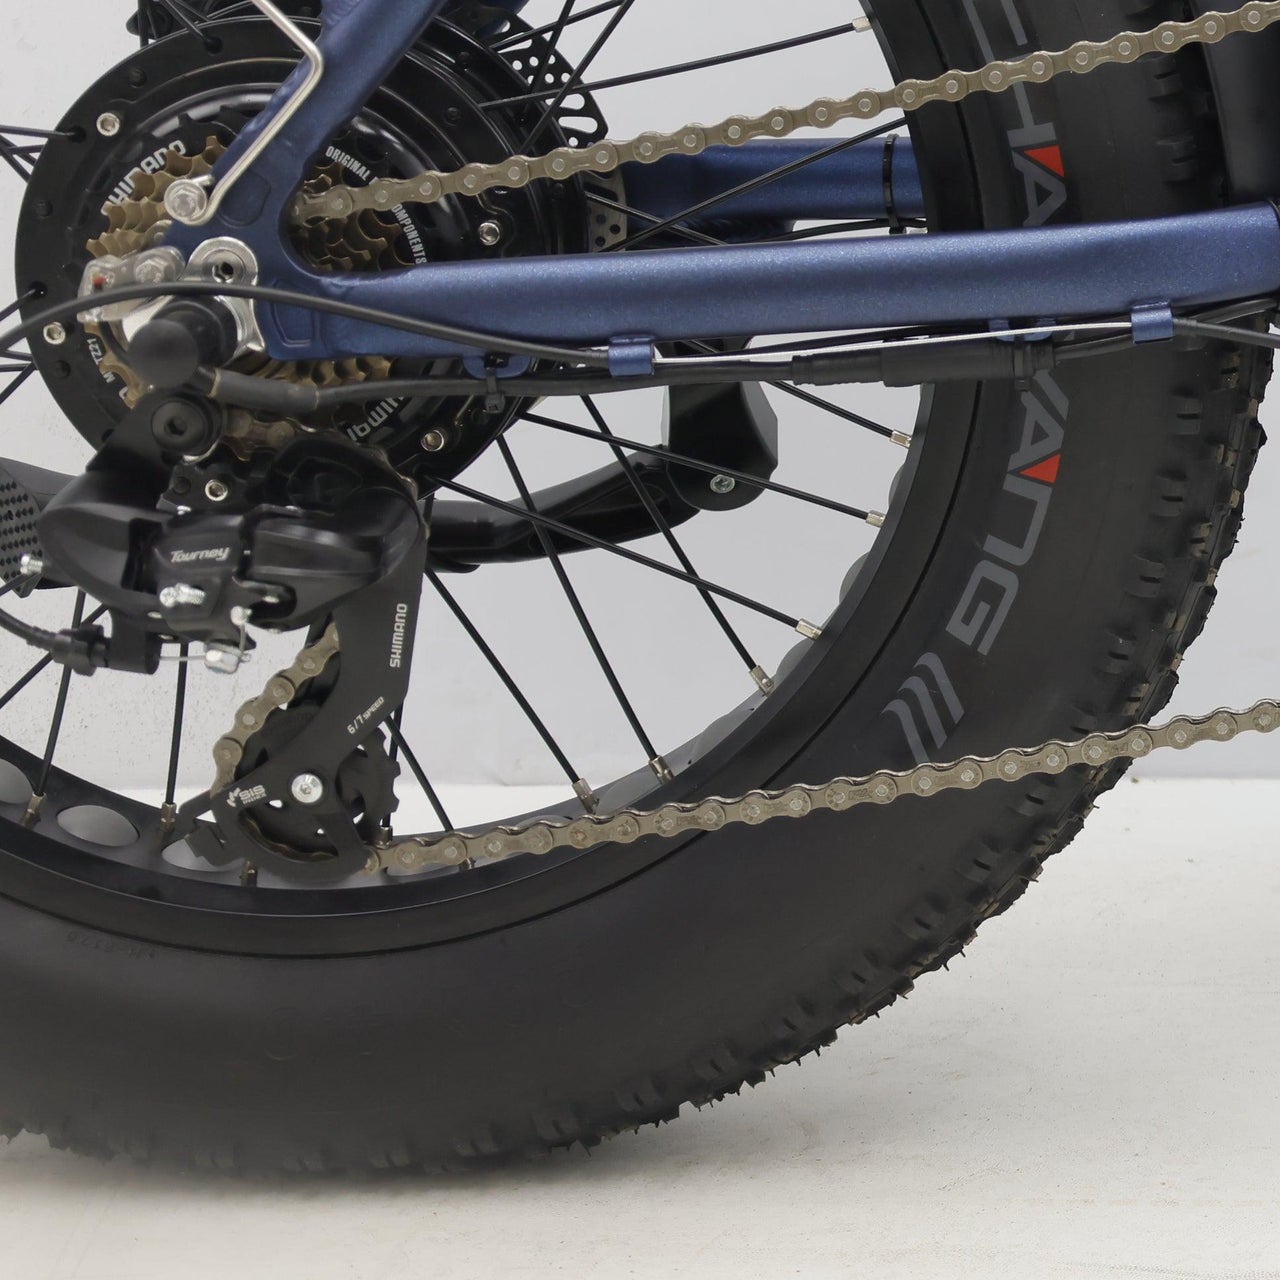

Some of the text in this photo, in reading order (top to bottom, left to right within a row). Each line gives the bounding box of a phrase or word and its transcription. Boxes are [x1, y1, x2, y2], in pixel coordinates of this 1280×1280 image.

[325, 145, 372, 181] ORIGINAL
[171, 546, 231, 564] Tourney
[389, 603, 408, 668] SHIMANO
